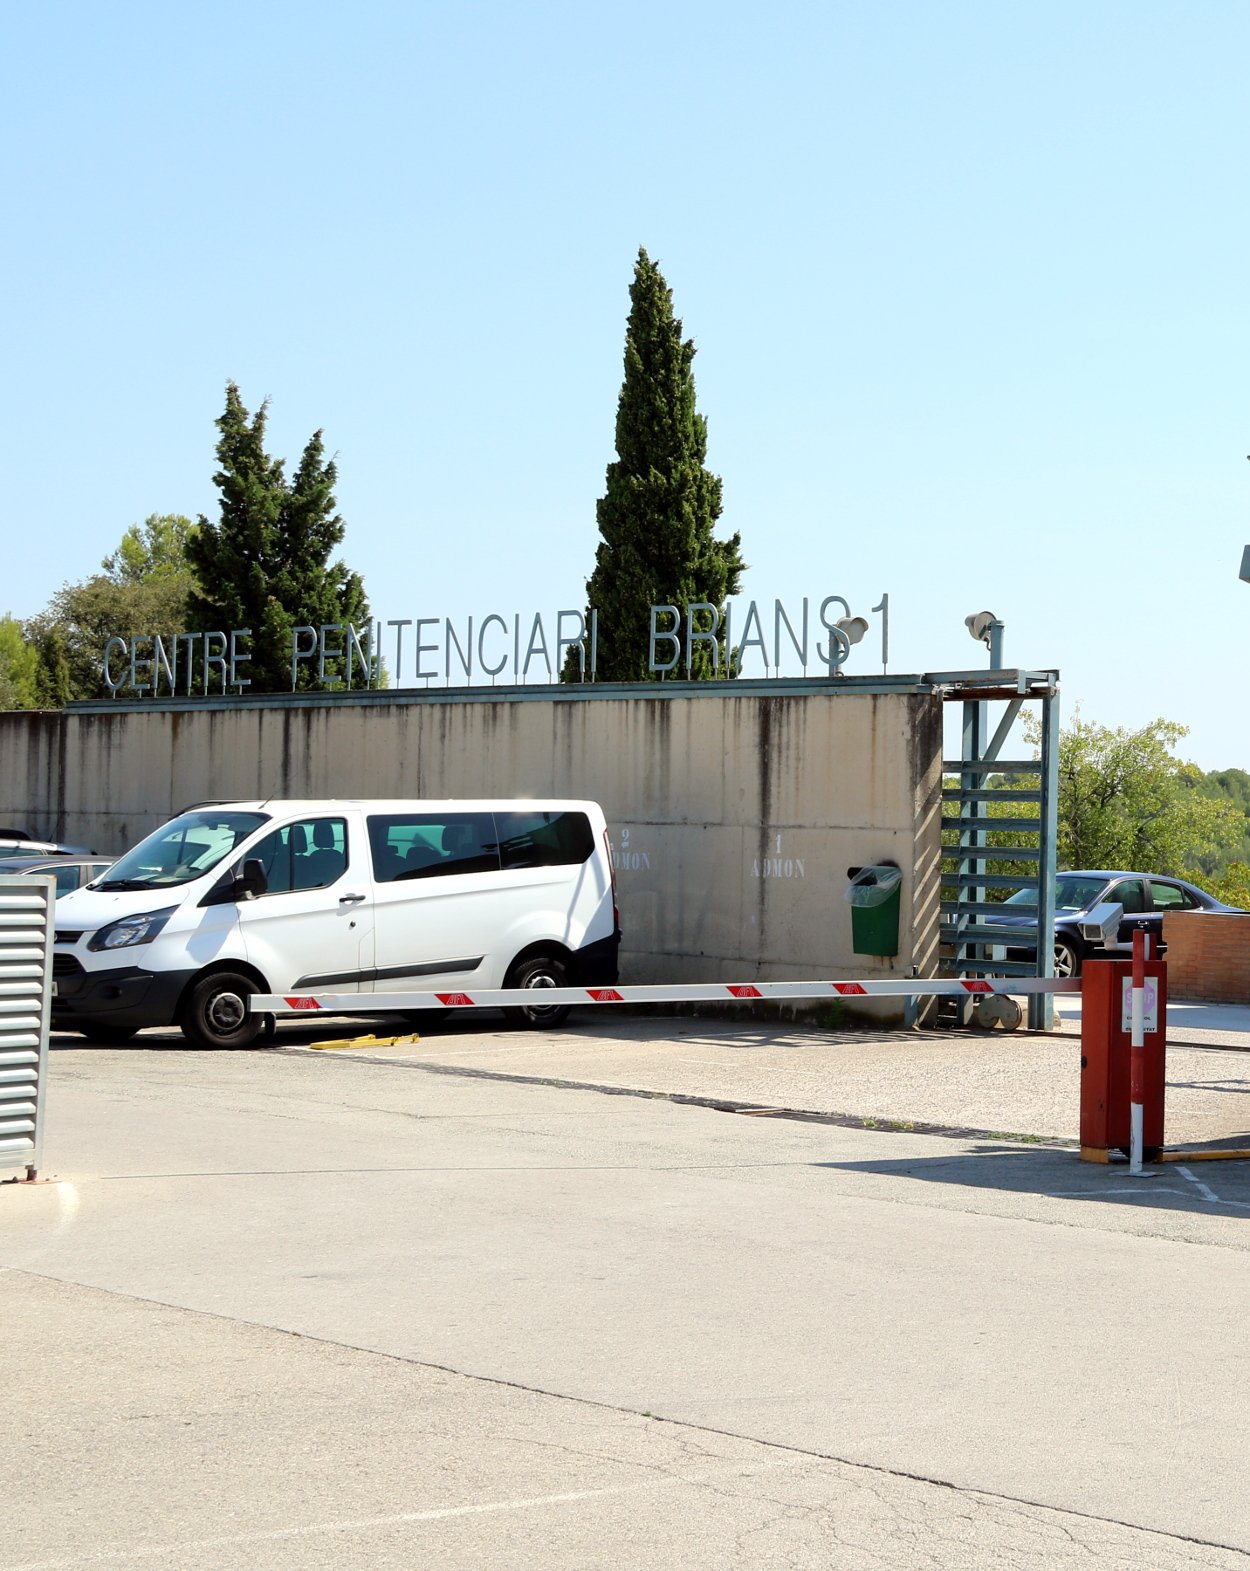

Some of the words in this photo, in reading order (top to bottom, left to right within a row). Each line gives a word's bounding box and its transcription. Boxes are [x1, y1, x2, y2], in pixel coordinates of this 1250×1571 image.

[104, 629, 252, 690] CENTRE
[291, 609, 597, 682] PENITENCIARI
[650, 596, 851, 671] BRIANS
[872, 593, 888, 664] 1
[621, 829, 630, 848] 2
[775, 834, 782, 853] 1
[612, 851, 650, 871] DMON
[750, 857, 806, 878] ADMON
